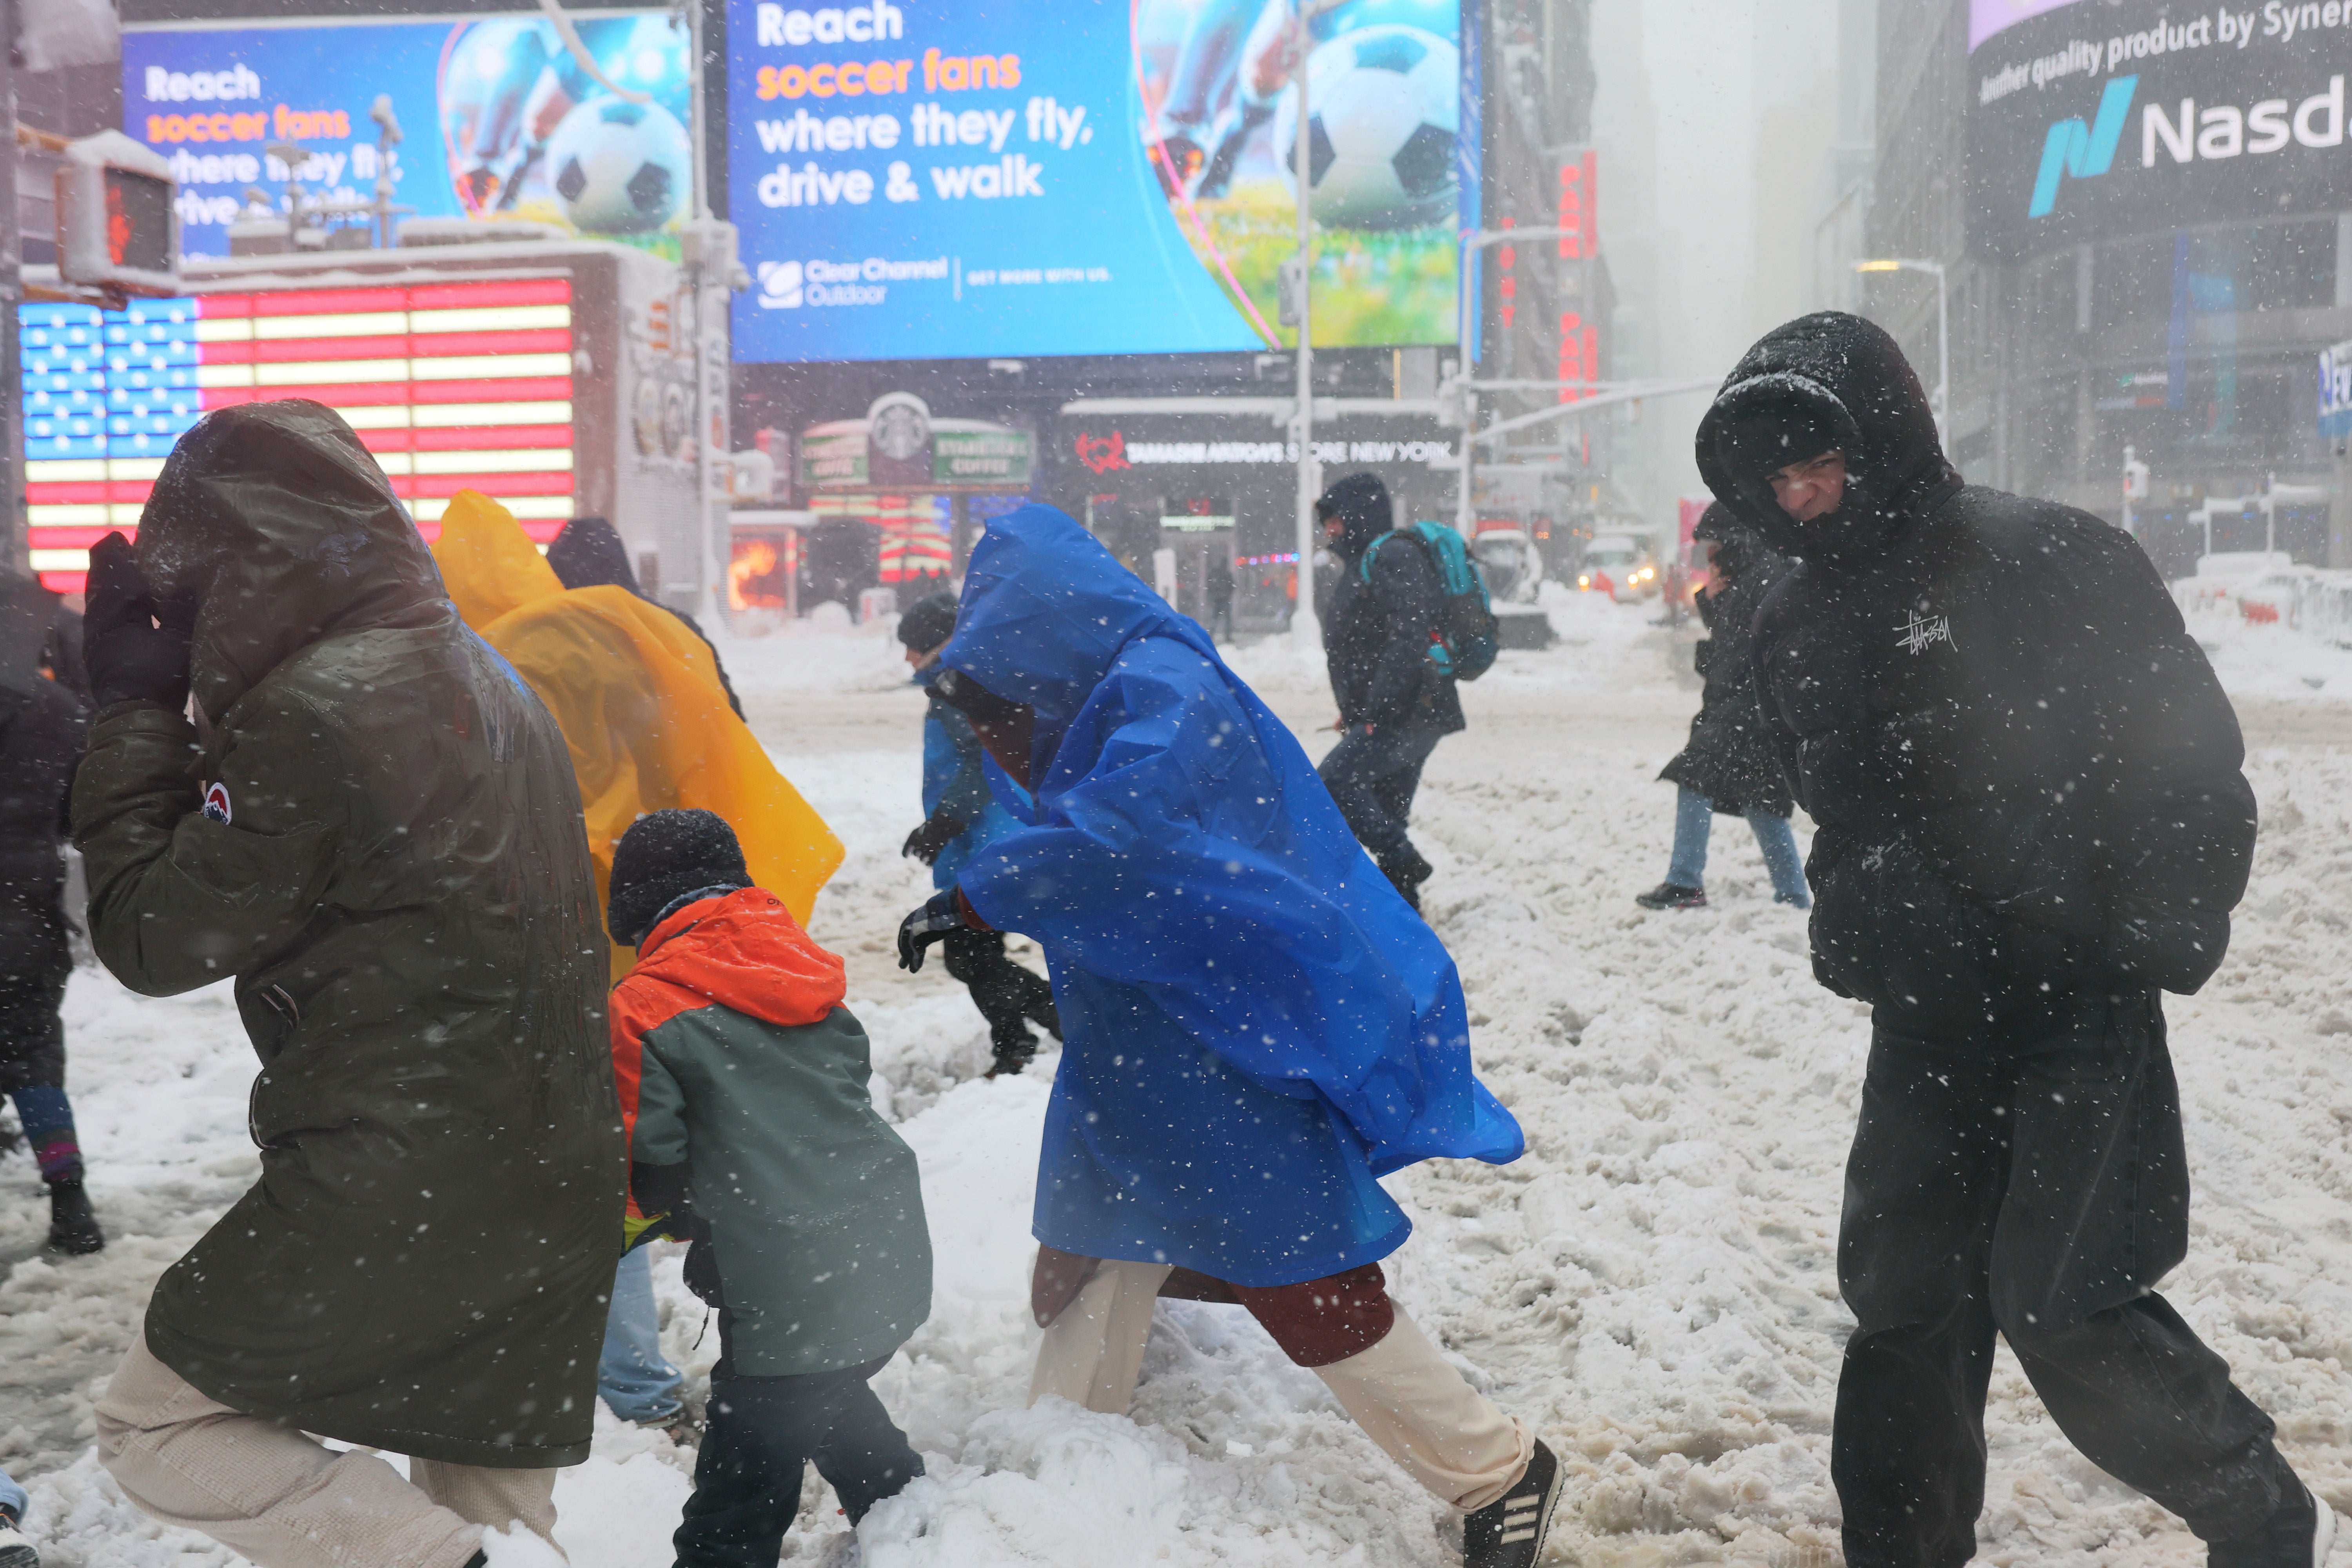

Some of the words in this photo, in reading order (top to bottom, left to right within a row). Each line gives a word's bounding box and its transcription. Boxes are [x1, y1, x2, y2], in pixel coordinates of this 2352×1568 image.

[757, 0, 902, 46] Reach
[2032, 40, 2103, 91] quality
[2108, 15, 2211, 72] product
[2218, 7, 2255, 49] by
[145, 63, 260, 101] Reach
[757, 59, 913, 100] soccer
[923, 47, 1021, 93] fans
[147, 111, 269, 143] soccer
[274, 103, 351, 140] fans
[756, 108, 900, 152] where
[911, 103, 1015, 152] they
[1026, 97, 1093, 150] fly,
[2141, 73, 2352, 168] Nasd
[169, 147, 260, 183] here
[757, 162, 874, 207] drive
[886, 161, 919, 202] &
[931, 154, 1044, 199] walk
[805, 259, 861, 282] Clear
[863, 256, 948, 281] Channel
[805, 283, 888, 307] Outdoor
[1286, 441, 1348, 463] SORE
[1350, 441, 1396, 463] NEW
[1396, 441, 1452, 463] YORK
